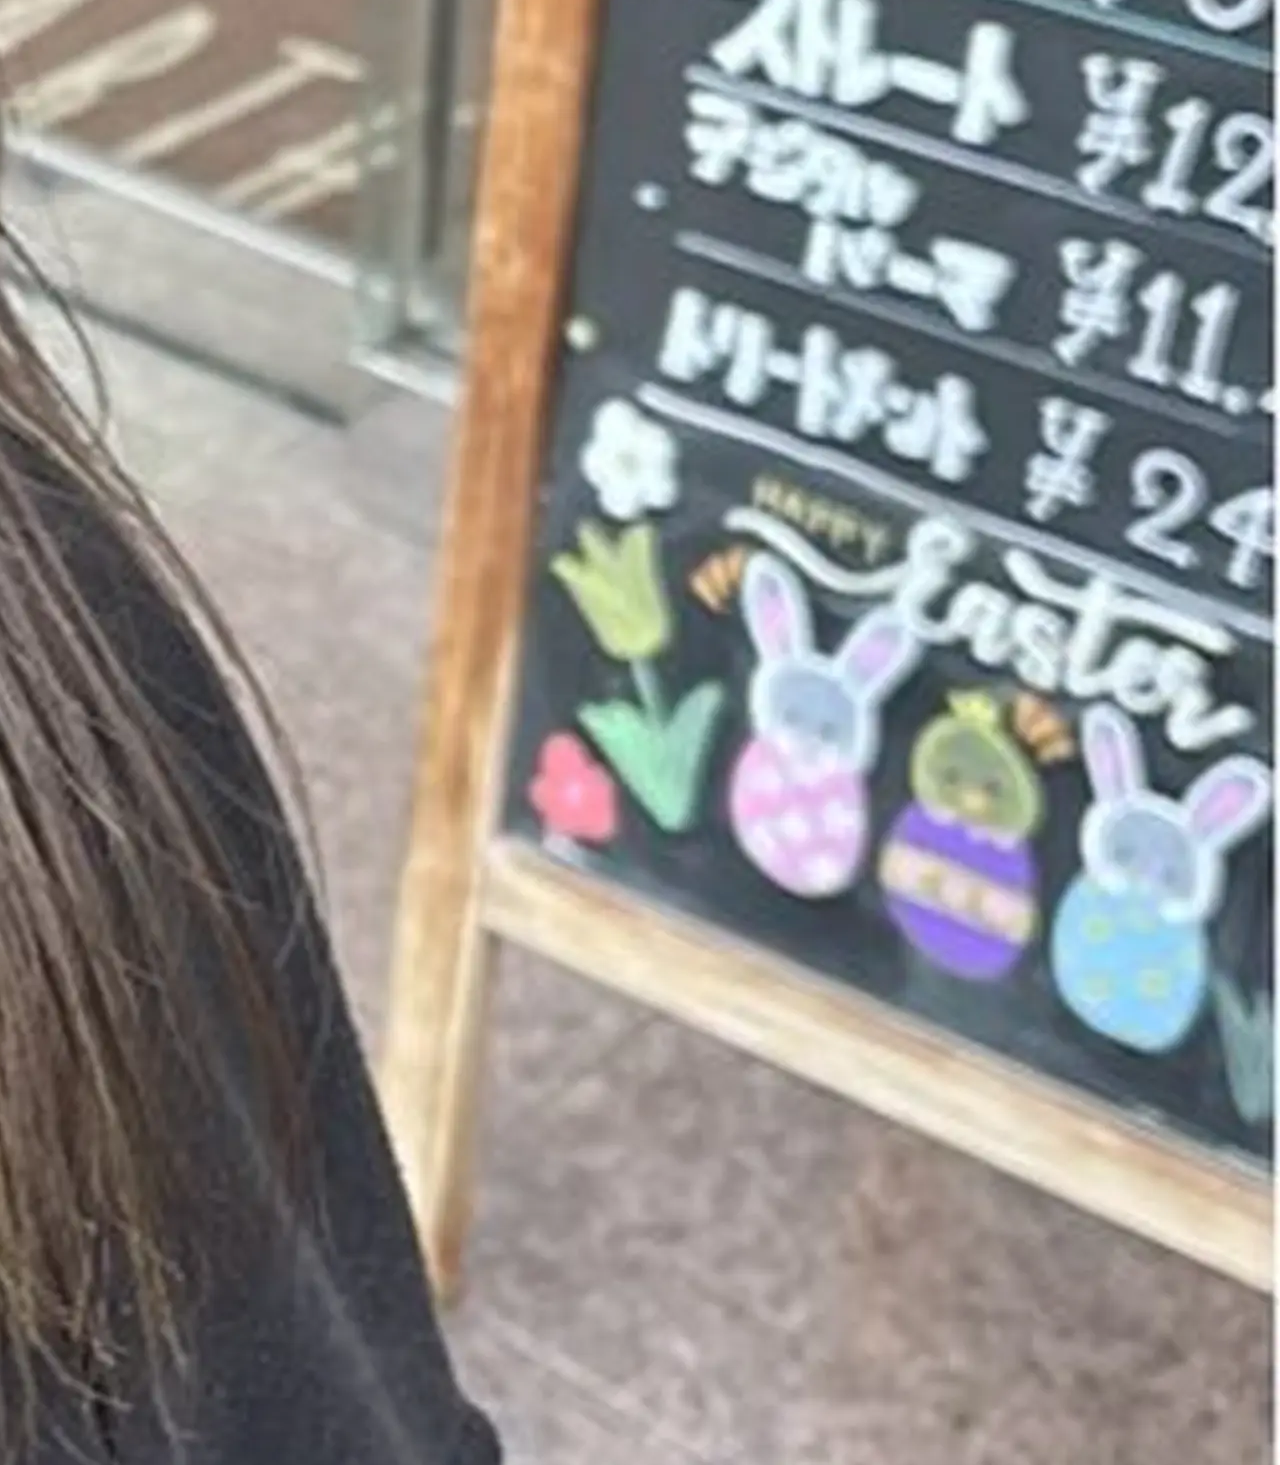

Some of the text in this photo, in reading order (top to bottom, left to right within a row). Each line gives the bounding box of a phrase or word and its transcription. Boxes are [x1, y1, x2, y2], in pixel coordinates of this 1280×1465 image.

[801, 218, 1018, 331] パーマ
[658, 286, 989, 483] トリートメント
[753, 474, 889, 564] HAPPY
[725, 515, 1255, 750] Easter
